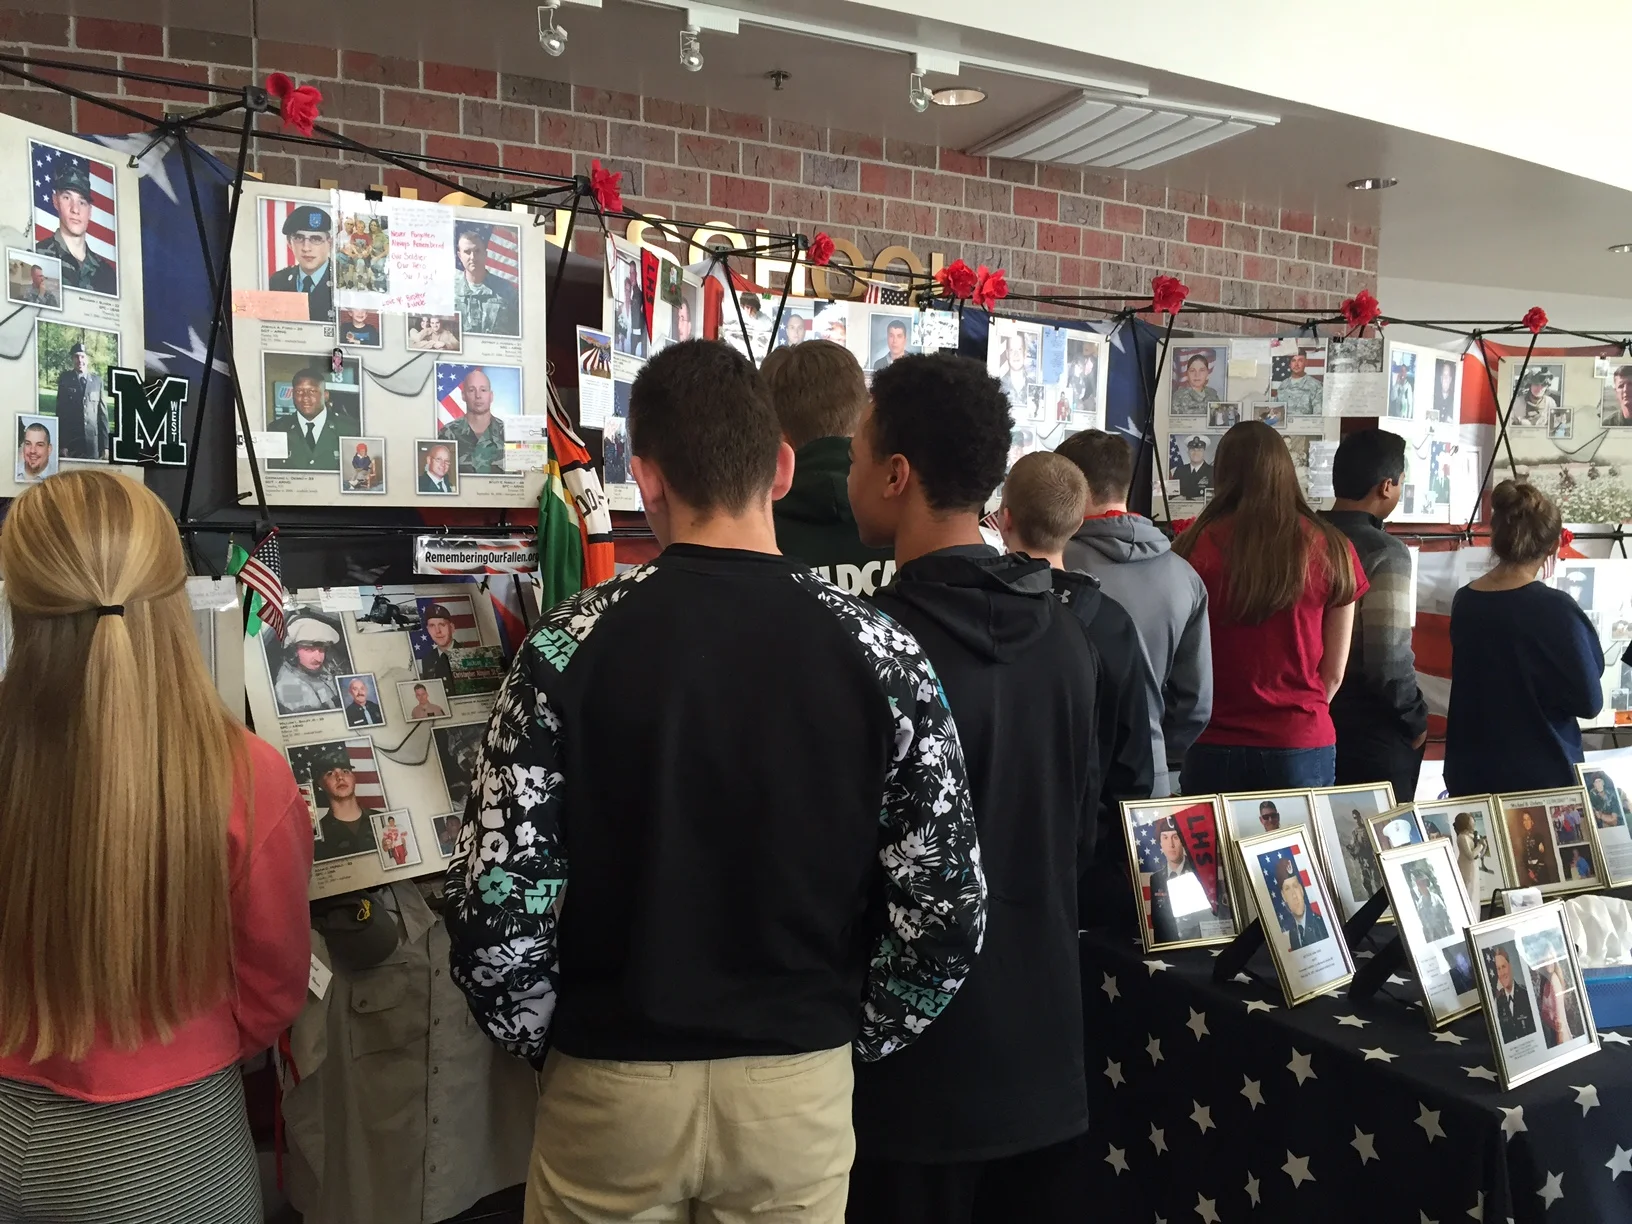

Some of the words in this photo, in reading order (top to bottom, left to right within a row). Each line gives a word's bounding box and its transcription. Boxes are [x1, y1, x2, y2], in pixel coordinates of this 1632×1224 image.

[391, 240, 410, 249] Always
[410, 231, 436, 241] Forgotten
[646, 264, 655, 305] LHS
[112, 369, 189, 466] M
[170, 400, 178, 442] WEST
[425, 551, 539, 565] RememberingOurFallen.org
[1187, 815, 1213, 866] LHS
